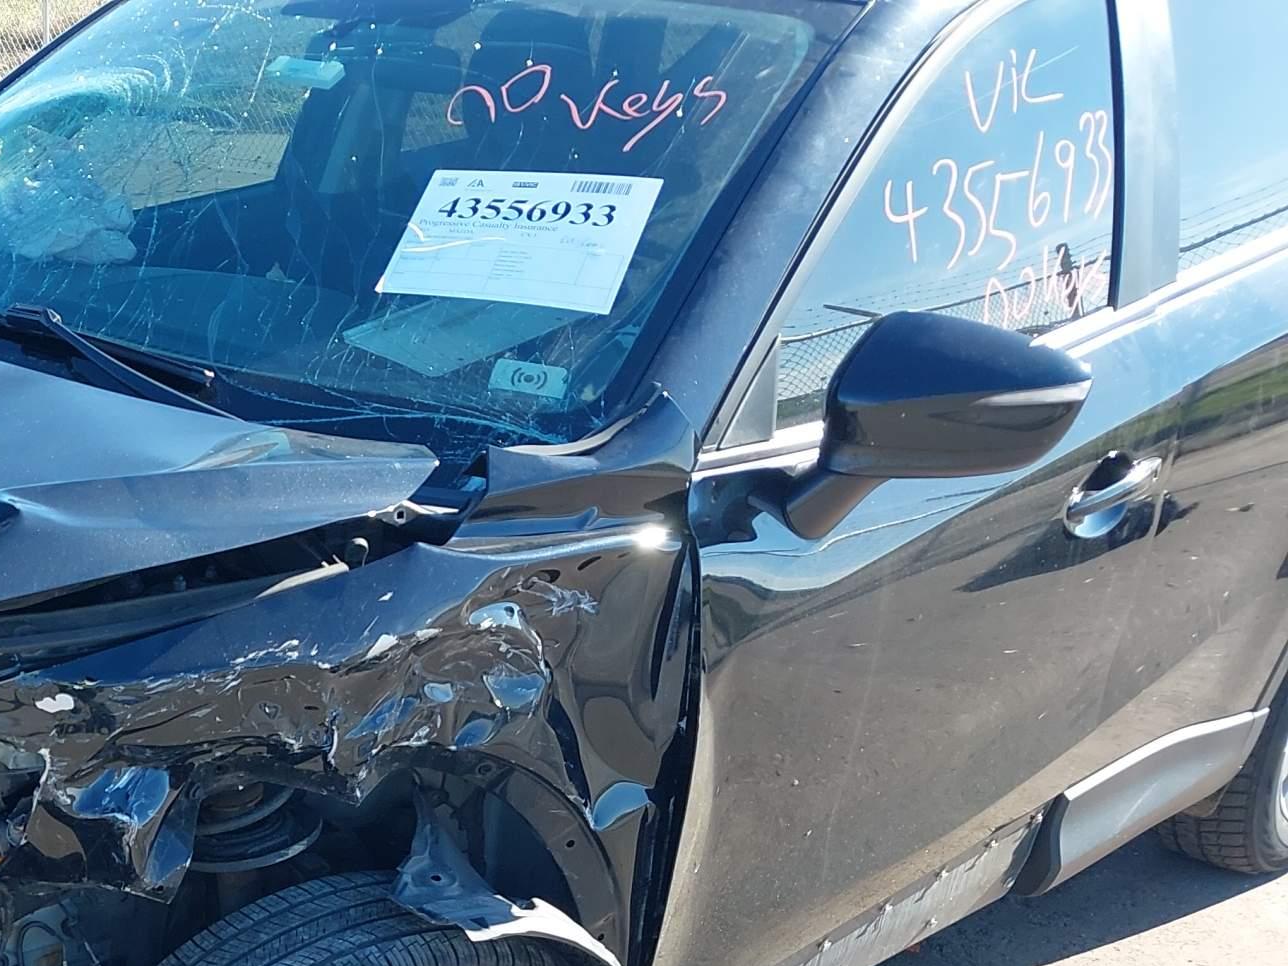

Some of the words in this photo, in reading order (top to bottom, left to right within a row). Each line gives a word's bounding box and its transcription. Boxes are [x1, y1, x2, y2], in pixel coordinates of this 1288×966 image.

[883, 110, 1112, 271] 43556933
[419, 219, 469, 229] Progressive
[472, 220, 511, 230] Casualty
[513, 223, 559, 232] Insurance
[438, 197, 617, 227] 43556933
